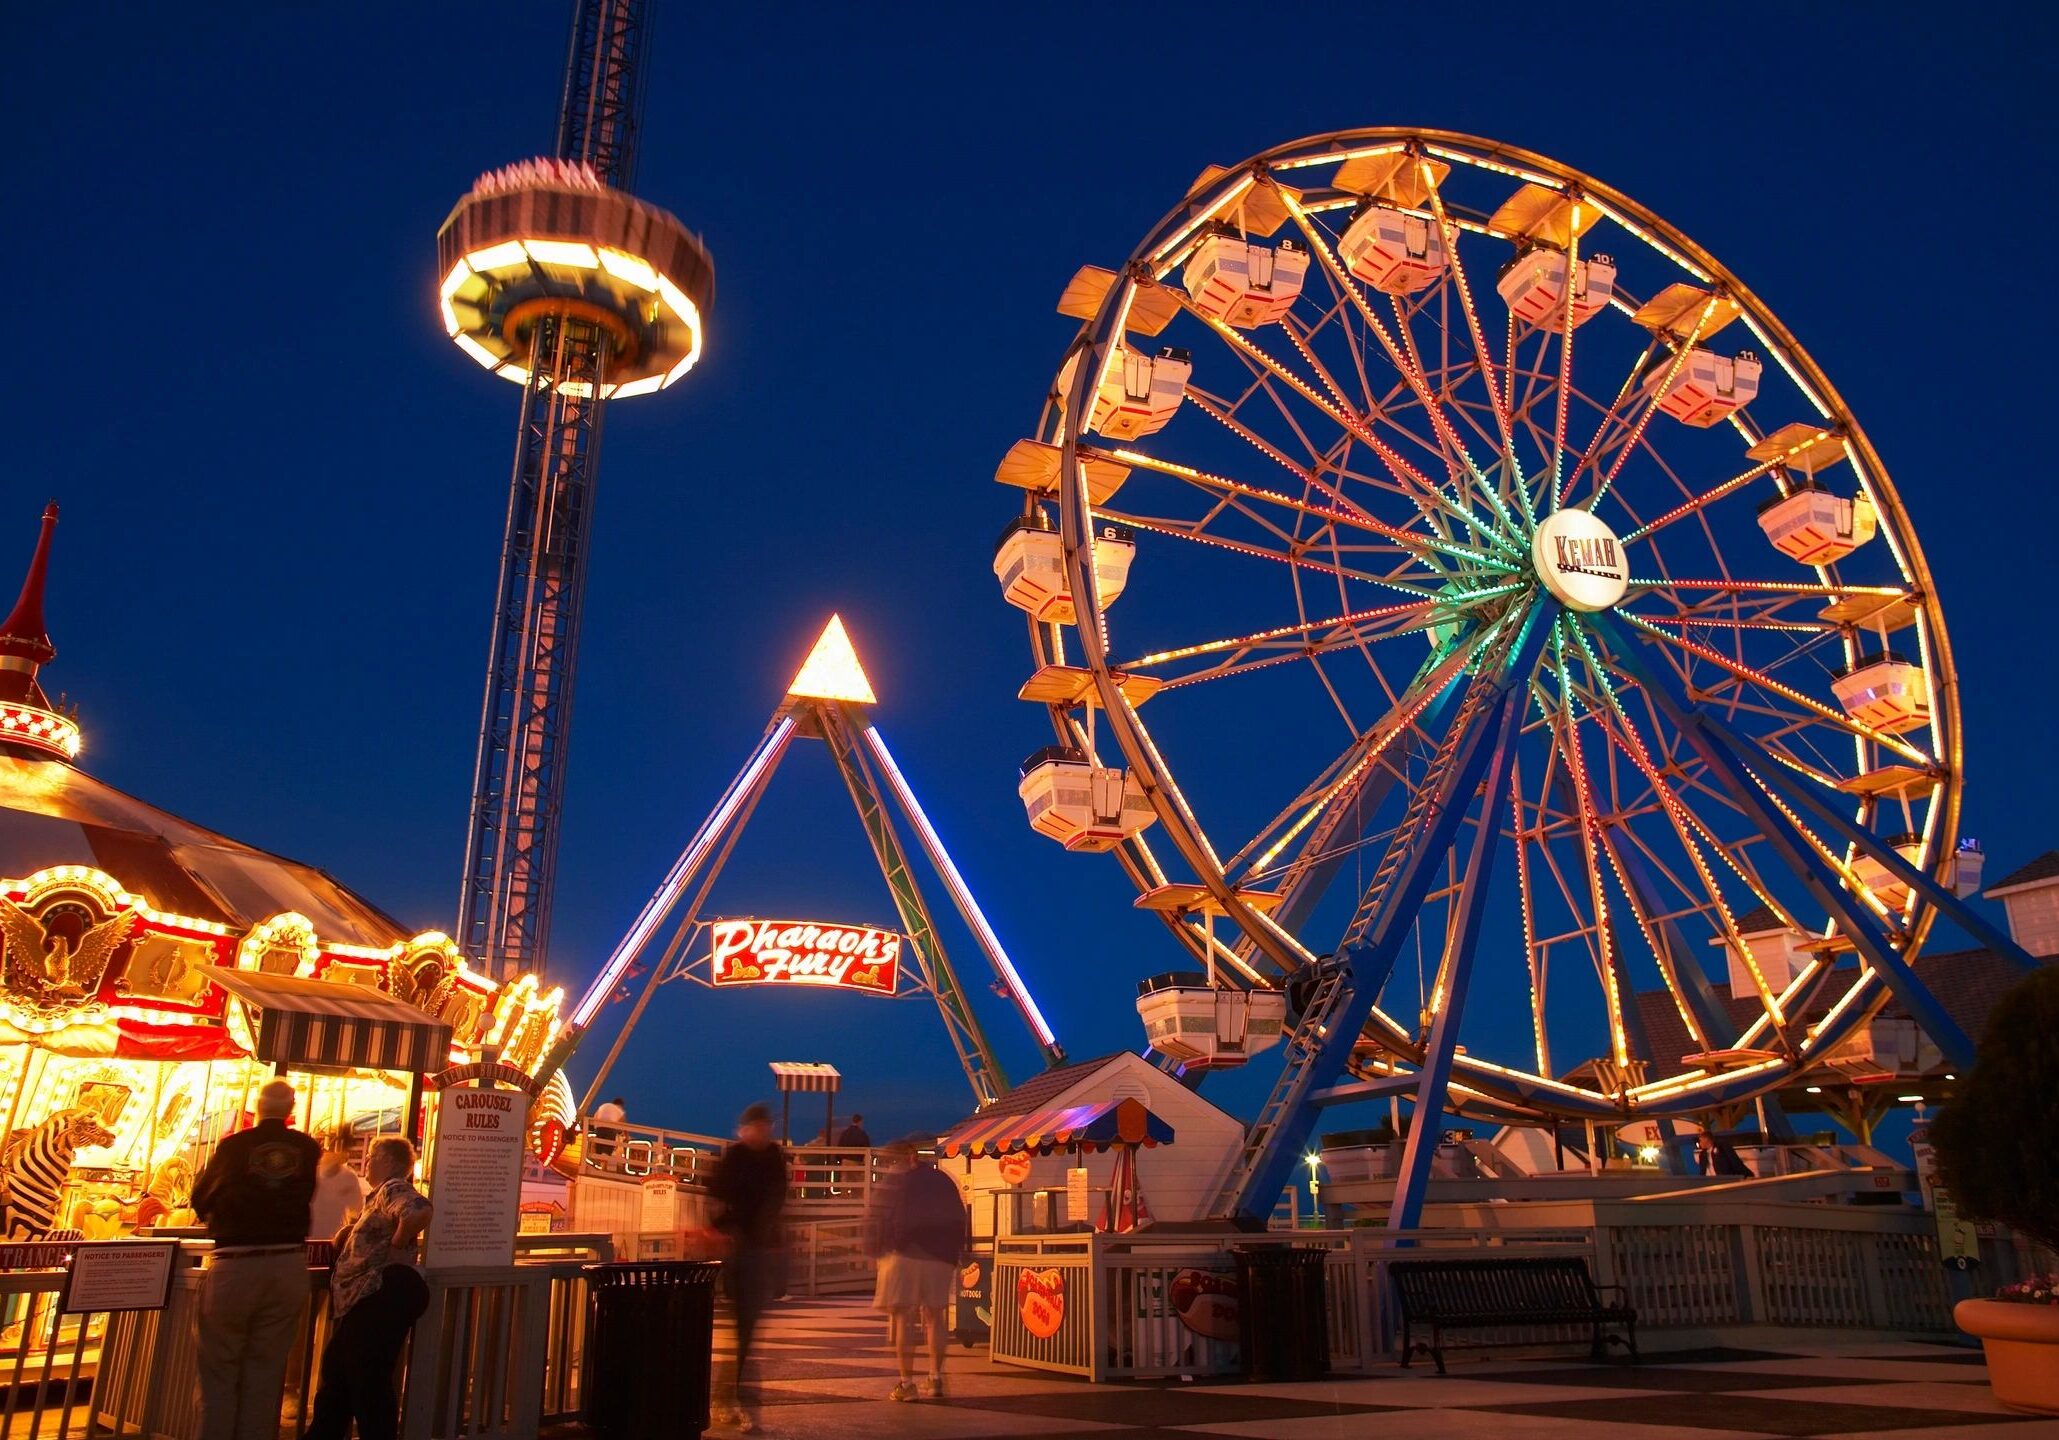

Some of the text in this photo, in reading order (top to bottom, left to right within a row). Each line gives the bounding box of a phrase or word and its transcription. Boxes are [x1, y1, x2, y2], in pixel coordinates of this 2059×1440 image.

[1282, 239, 1293, 250] 8
[1594, 253, 1610, 265] 10
[1163, 346, 1173, 358] 7
[1740, 350, 1754, 361] 11
[1104, 527, 1116, 539] 6
[715, 920, 899, 974] Pharaoh's
[757, 949, 855, 985] Fury
[455, 1094, 512, 1112] CAROUSEL
[466, 1113, 500, 1129] RULES
[442, 1134, 465, 1142] NOTICE
[477, 1135, 519, 1143] PASSENGERS
[1644, 1126, 1660, 1141] EX
[1, 1247, 66, 1267] TRANCE
[122, 1251, 165, 1259] PASSENGERS
